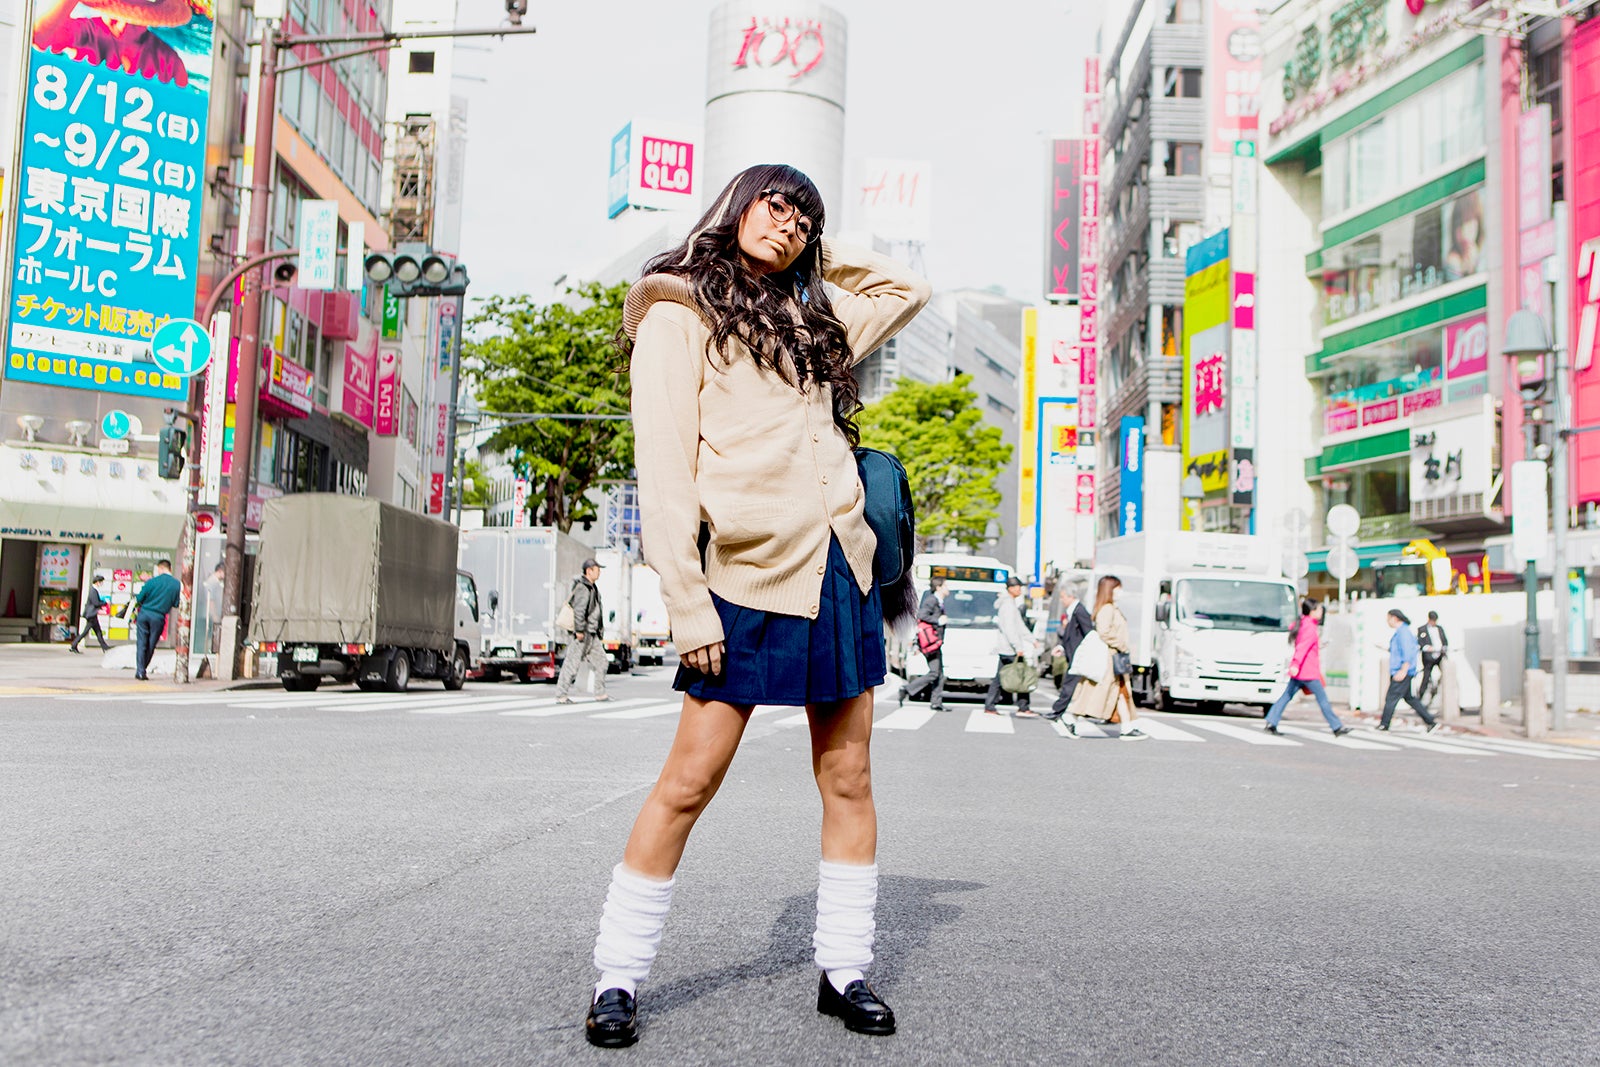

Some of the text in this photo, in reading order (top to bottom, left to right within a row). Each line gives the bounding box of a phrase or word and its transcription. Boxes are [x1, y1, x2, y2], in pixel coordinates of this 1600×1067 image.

[731, 23, 826, 79] 109
[645, 139, 687, 168] UNI
[644, 163, 690, 191] QLO
[859, 169, 920, 208] HM
[24, 166, 191, 240] 東京国際
[22, 213, 187, 280] フォーラム
[17, 255, 118, 298] ホールC
[1449, 321, 1487, 372] JTB
[336, 460, 368, 497] LUSH
